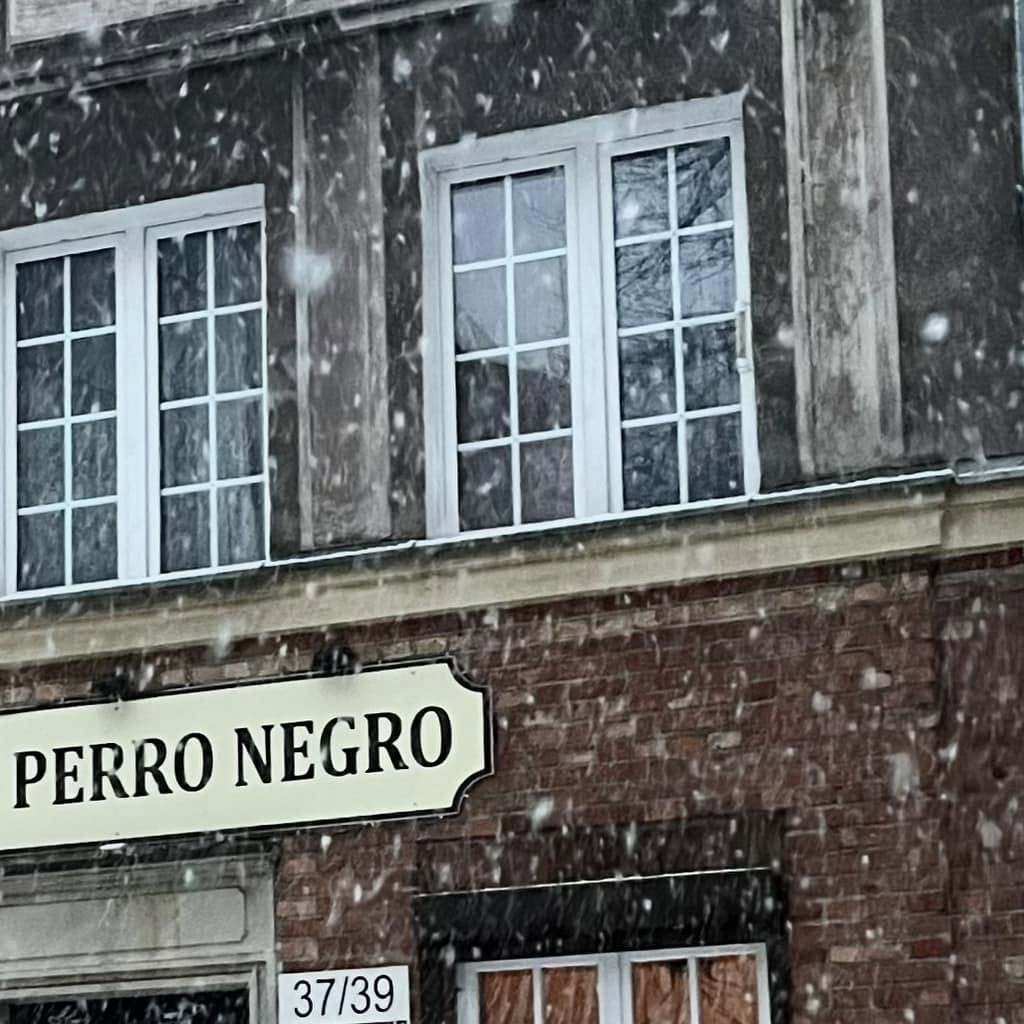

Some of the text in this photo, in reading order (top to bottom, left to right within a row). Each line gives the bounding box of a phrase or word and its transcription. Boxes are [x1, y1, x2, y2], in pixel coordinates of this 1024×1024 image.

[12, 732, 214, 809] PERRO
[234, 705, 453, 787] NEGRO
[294, 974, 394, 1018] 37/39
